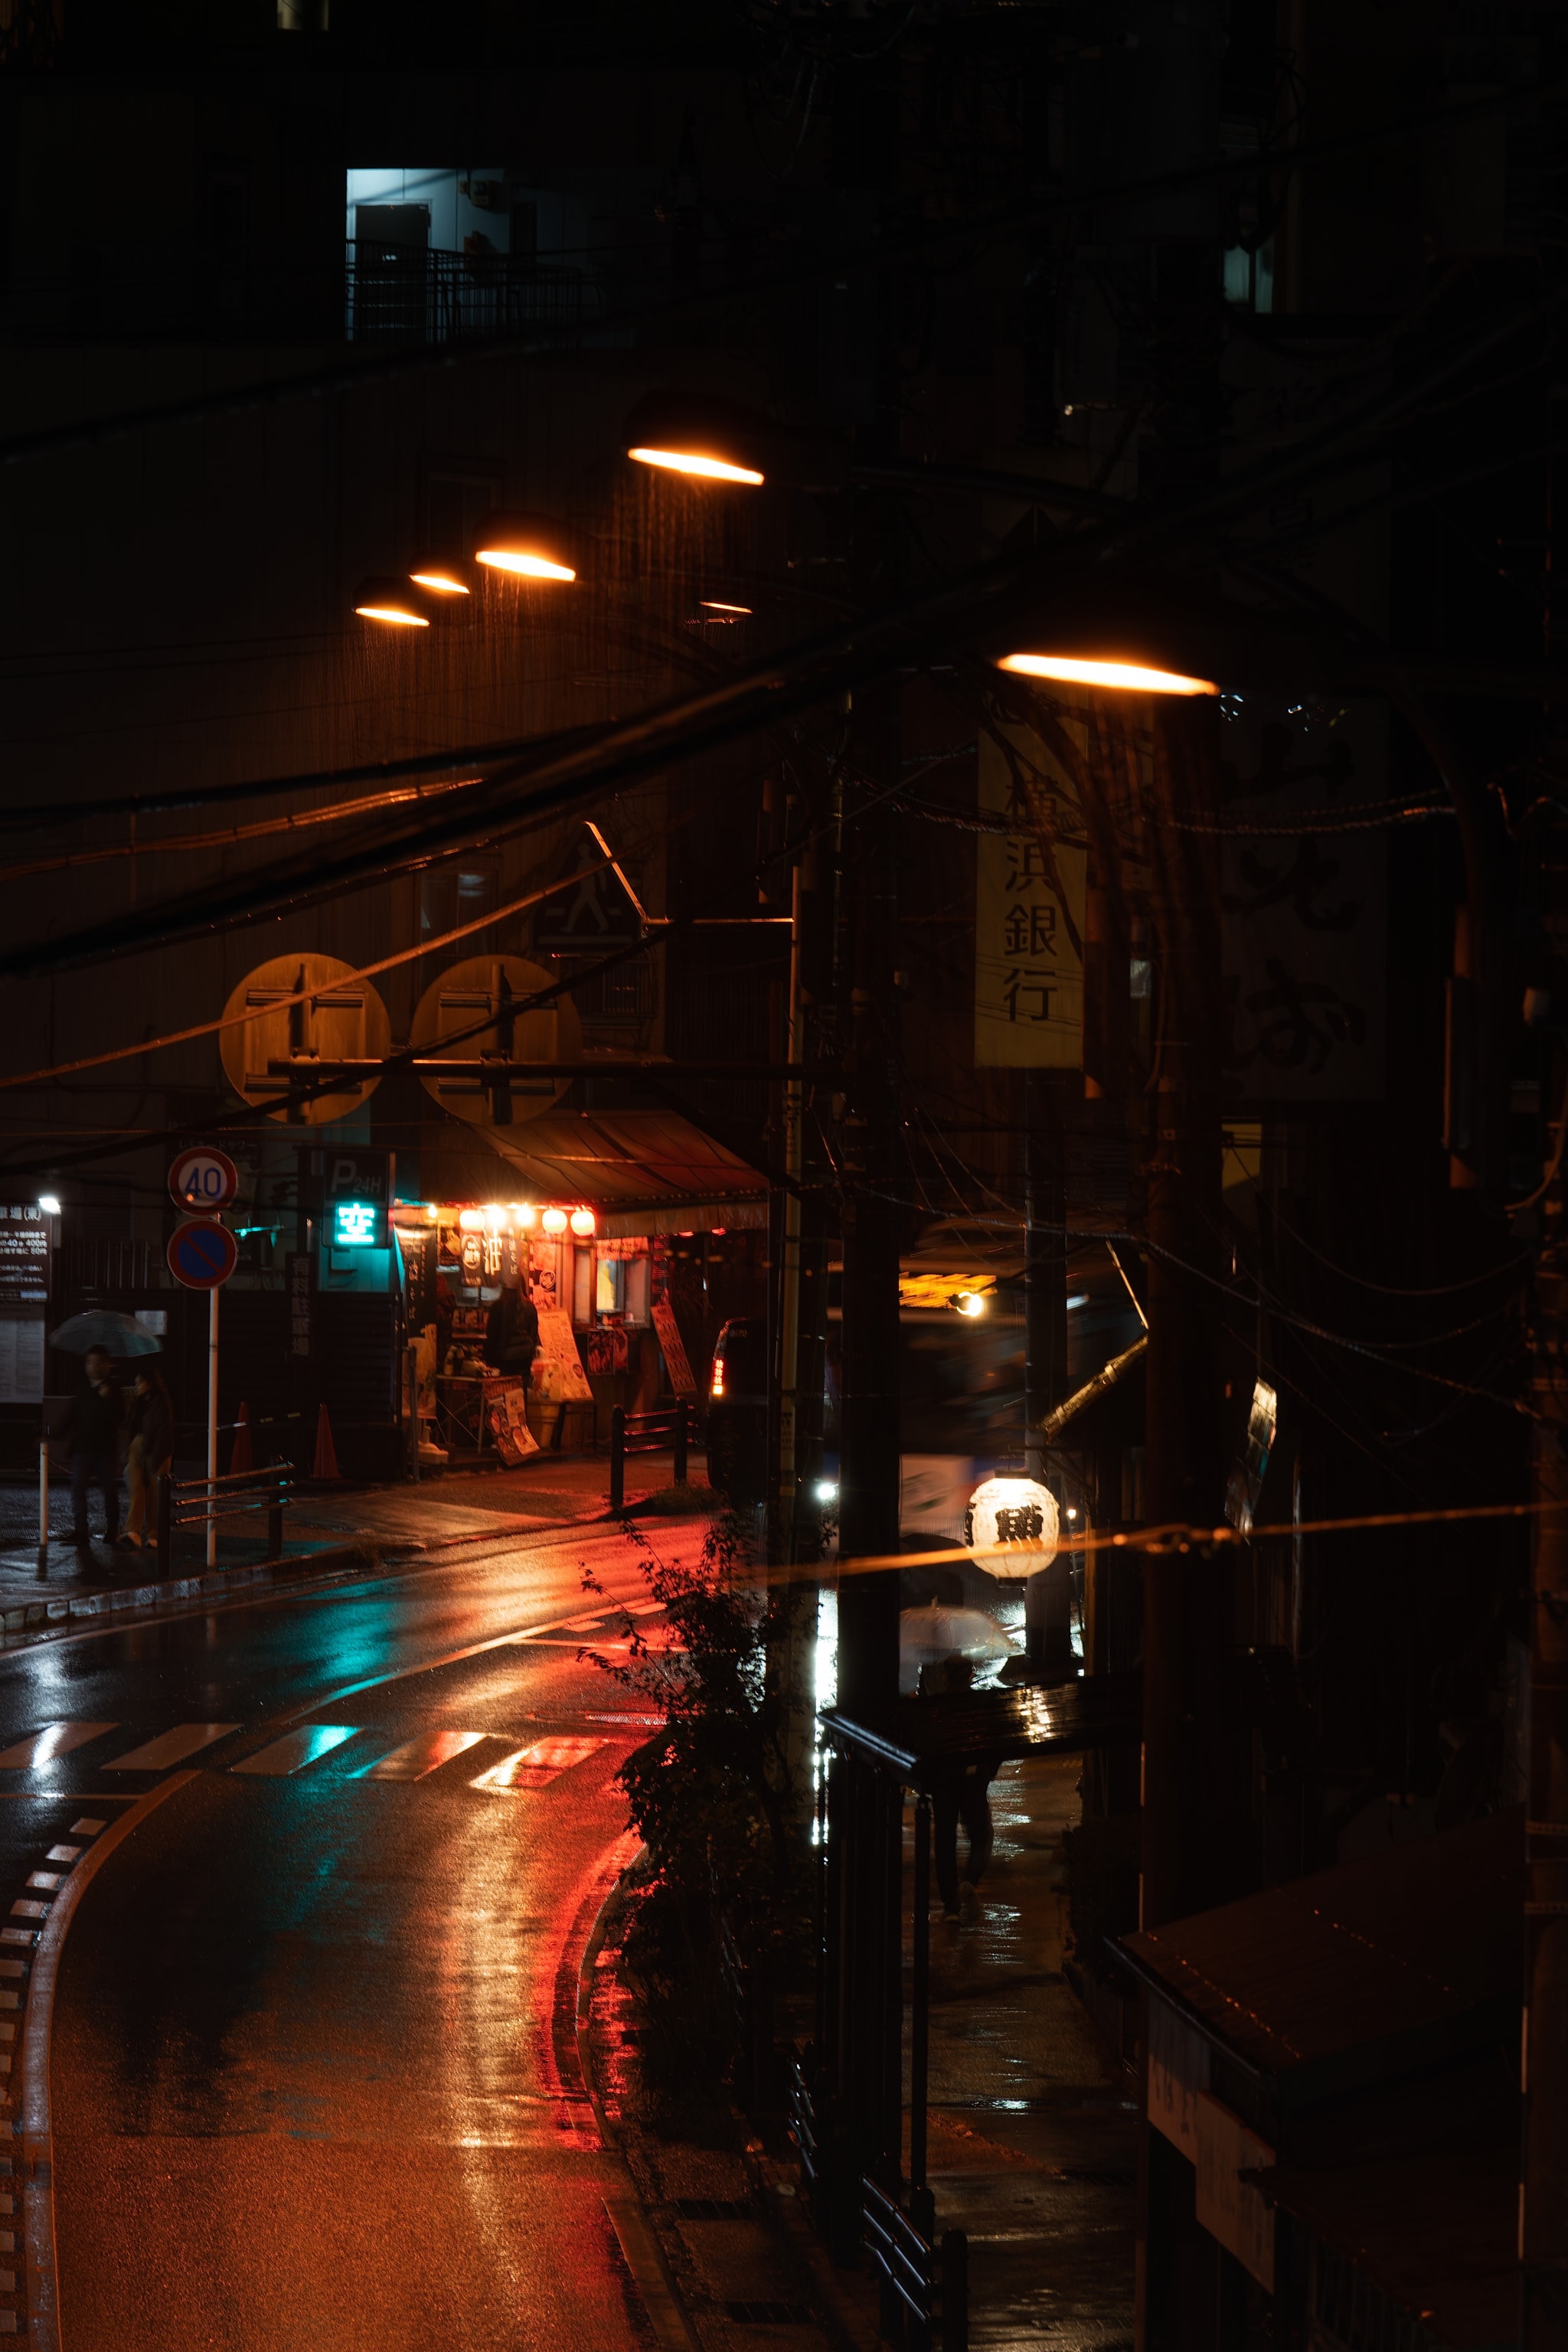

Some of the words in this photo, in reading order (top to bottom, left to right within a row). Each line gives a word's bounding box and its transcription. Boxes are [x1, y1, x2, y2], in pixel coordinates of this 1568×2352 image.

[185, 1168, 220, 1197] 40
[331, 1158, 357, 1193] P
[337, 1201, 375, 1243] 空
